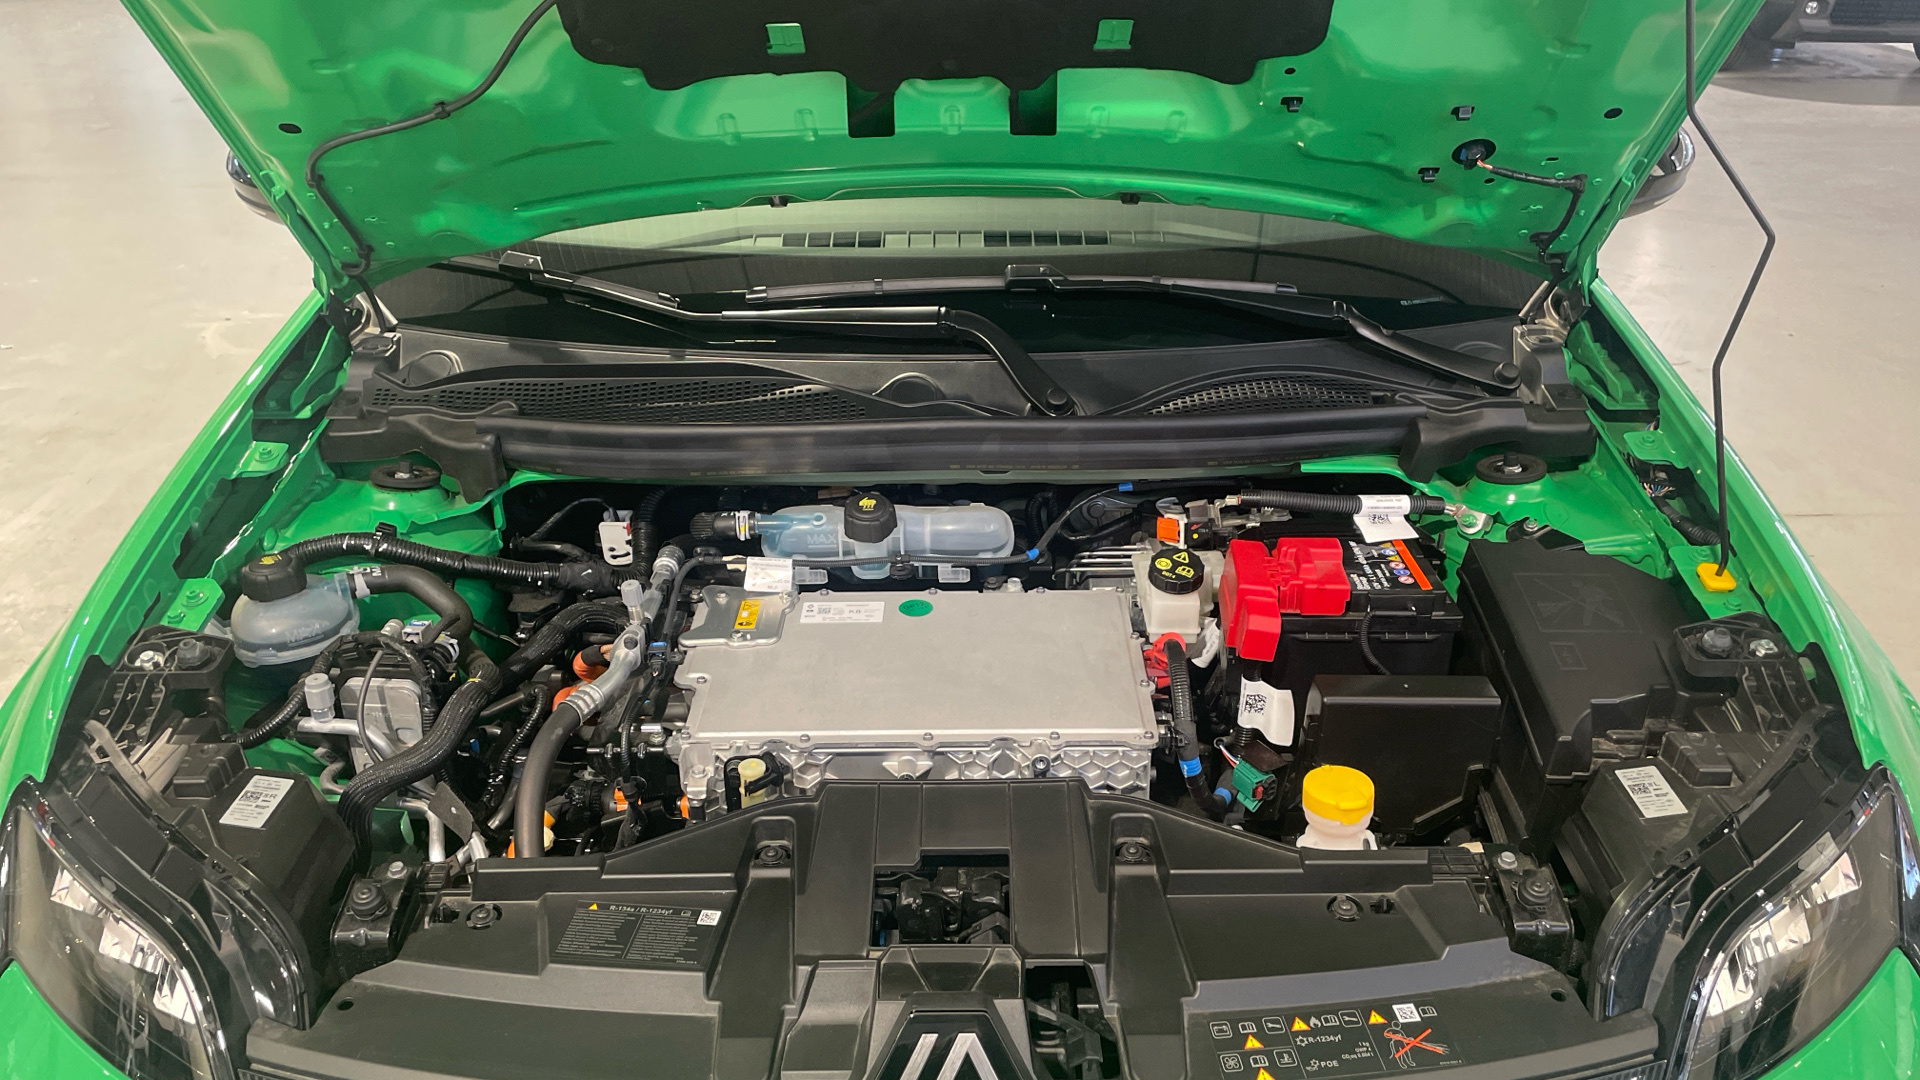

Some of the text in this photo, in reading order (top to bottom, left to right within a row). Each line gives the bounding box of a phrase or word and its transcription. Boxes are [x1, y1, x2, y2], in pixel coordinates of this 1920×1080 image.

[806, 533, 837, 545] MAX
[640, 907, 674, 915] R-1234yf
[1307, 1034, 1342, 1044] R-1234yf
[1320, 1059, 1339, 1068] POE
